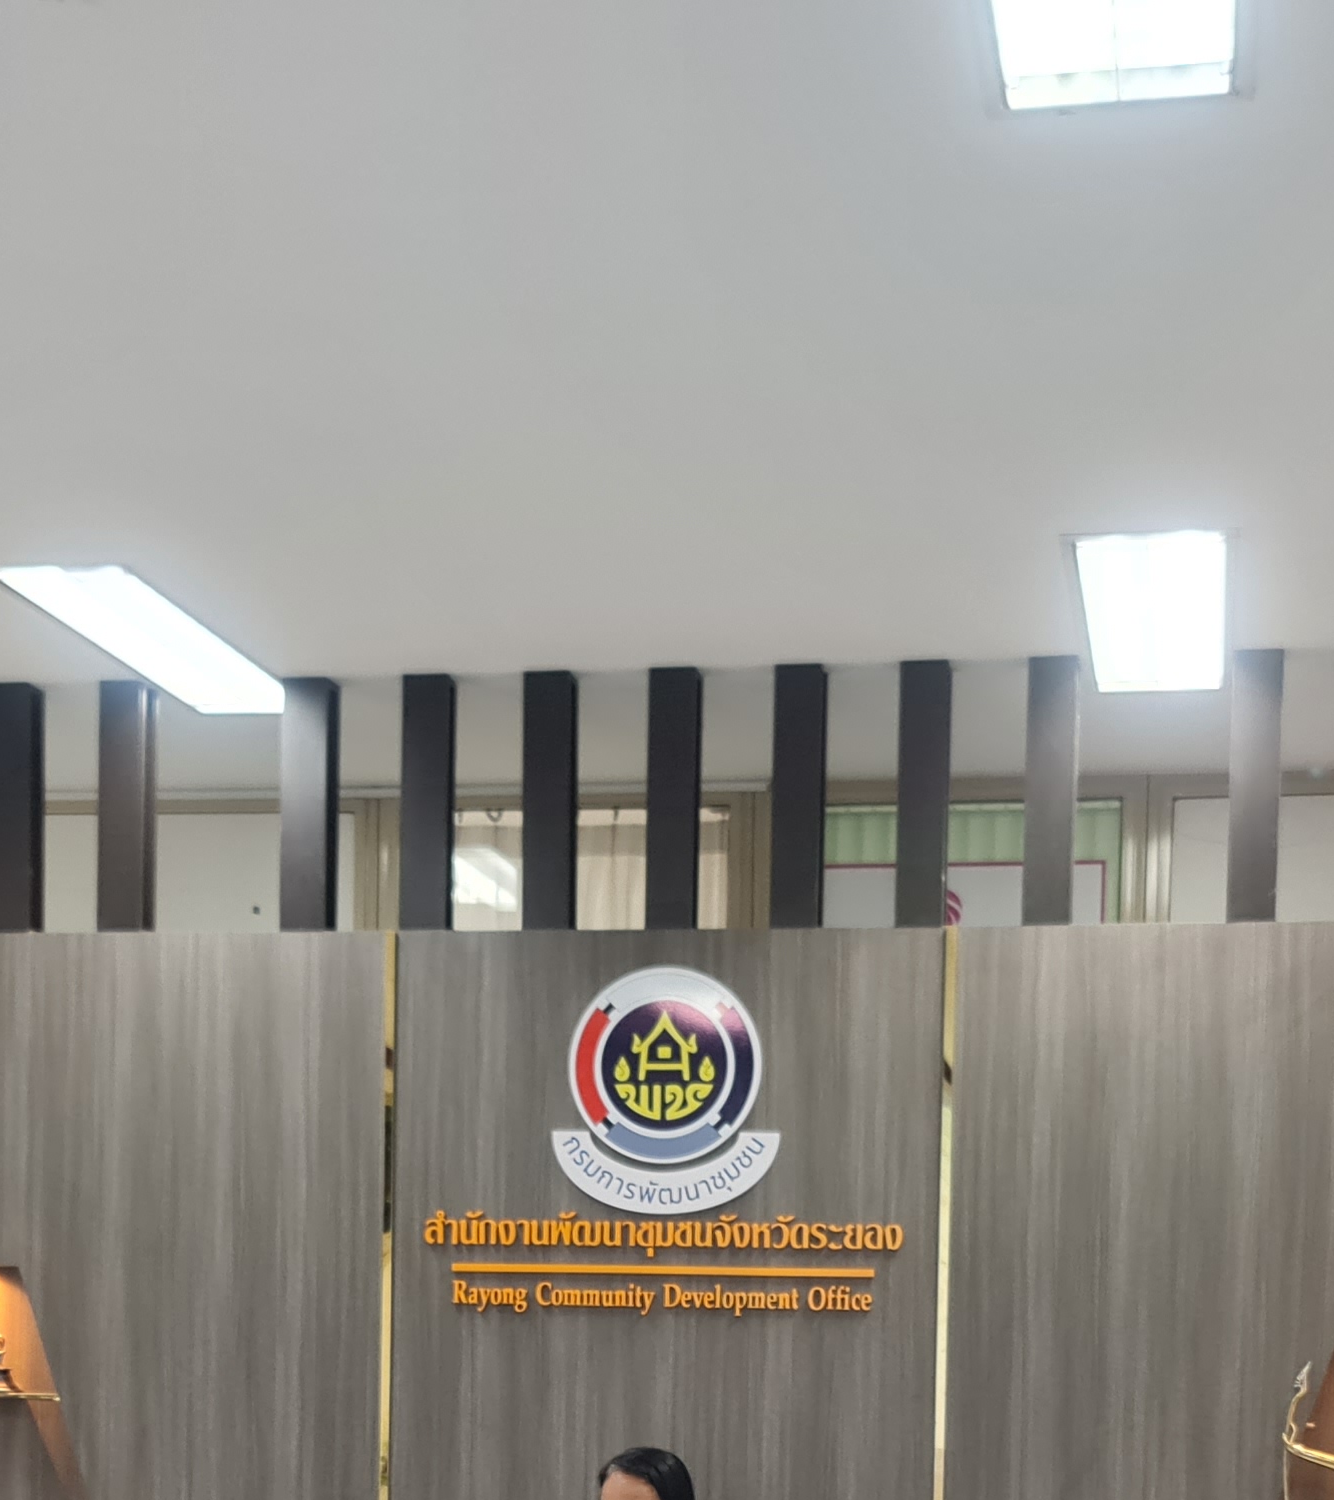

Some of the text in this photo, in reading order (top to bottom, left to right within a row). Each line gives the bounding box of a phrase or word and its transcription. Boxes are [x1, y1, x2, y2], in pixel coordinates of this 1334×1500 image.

[563, 1136, 766, 1205] กรมการพัฒนาชุมชน
[424, 1211, 904, 1257] สำนักงานพัฒนาชุมชนจังหวัดระยอง
[452, 1280, 873, 1316] Rayong Community Development Office
